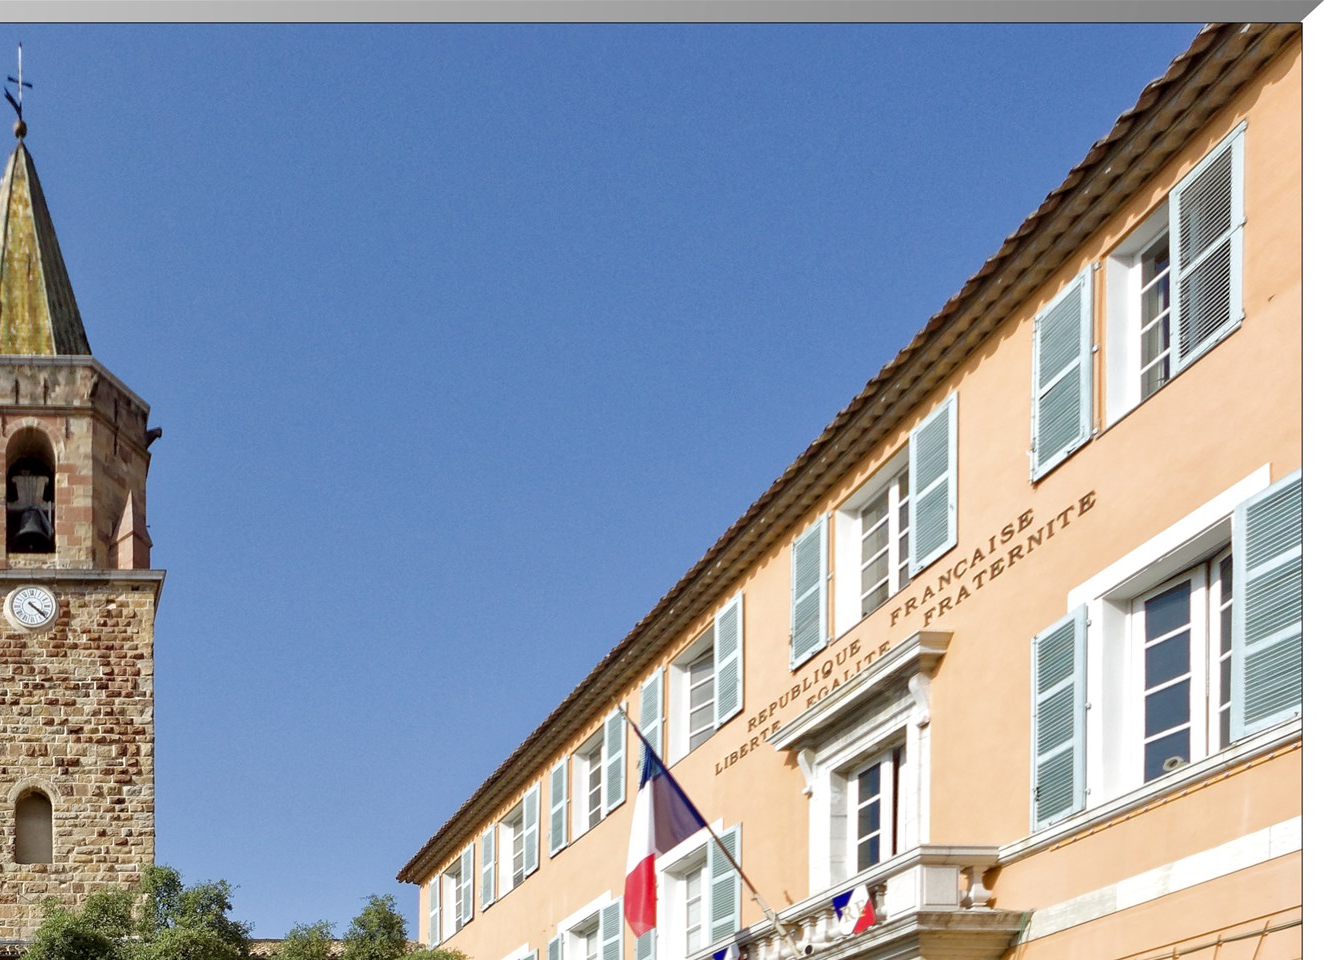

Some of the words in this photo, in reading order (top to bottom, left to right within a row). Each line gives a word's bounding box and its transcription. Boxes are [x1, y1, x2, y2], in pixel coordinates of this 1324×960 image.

[714, 719, 783, 777] LIBERTE
[923, 489, 1098, 628] FRATERNITE
[747, 638, 862, 733] REPUBLIQUE
